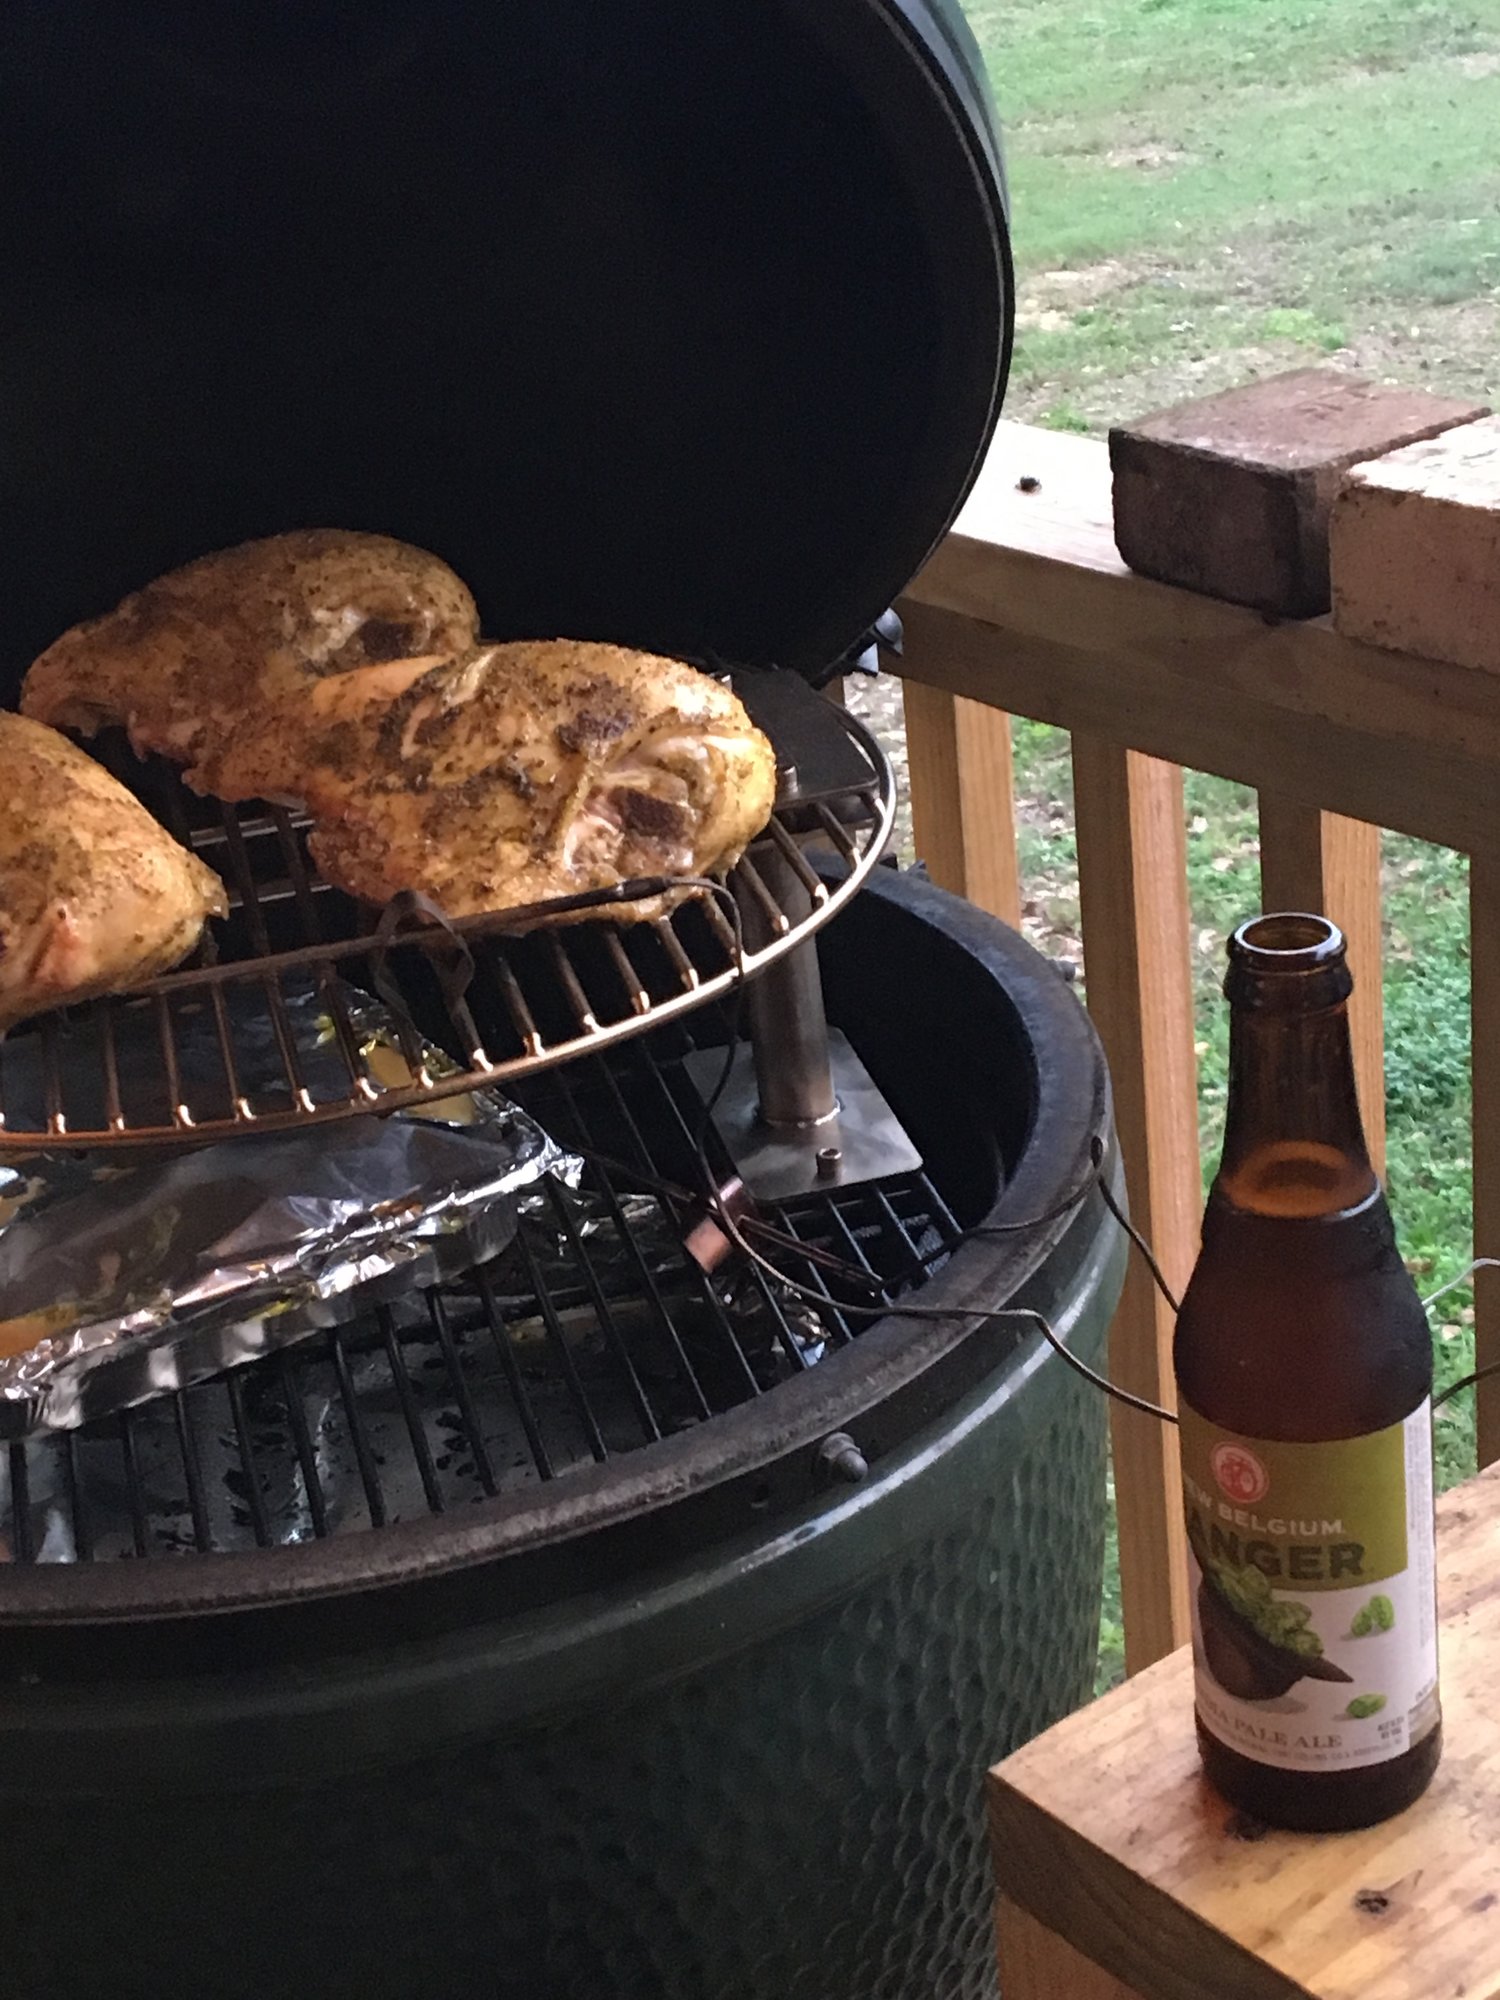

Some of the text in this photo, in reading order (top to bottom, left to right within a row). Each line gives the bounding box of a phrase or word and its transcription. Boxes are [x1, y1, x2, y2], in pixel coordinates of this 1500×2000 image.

[1218, 1503, 1343, 1536] BELGIUM
[1234, 1717, 1287, 1746] PALE
[1293, 1734, 1342, 1749] ALE
